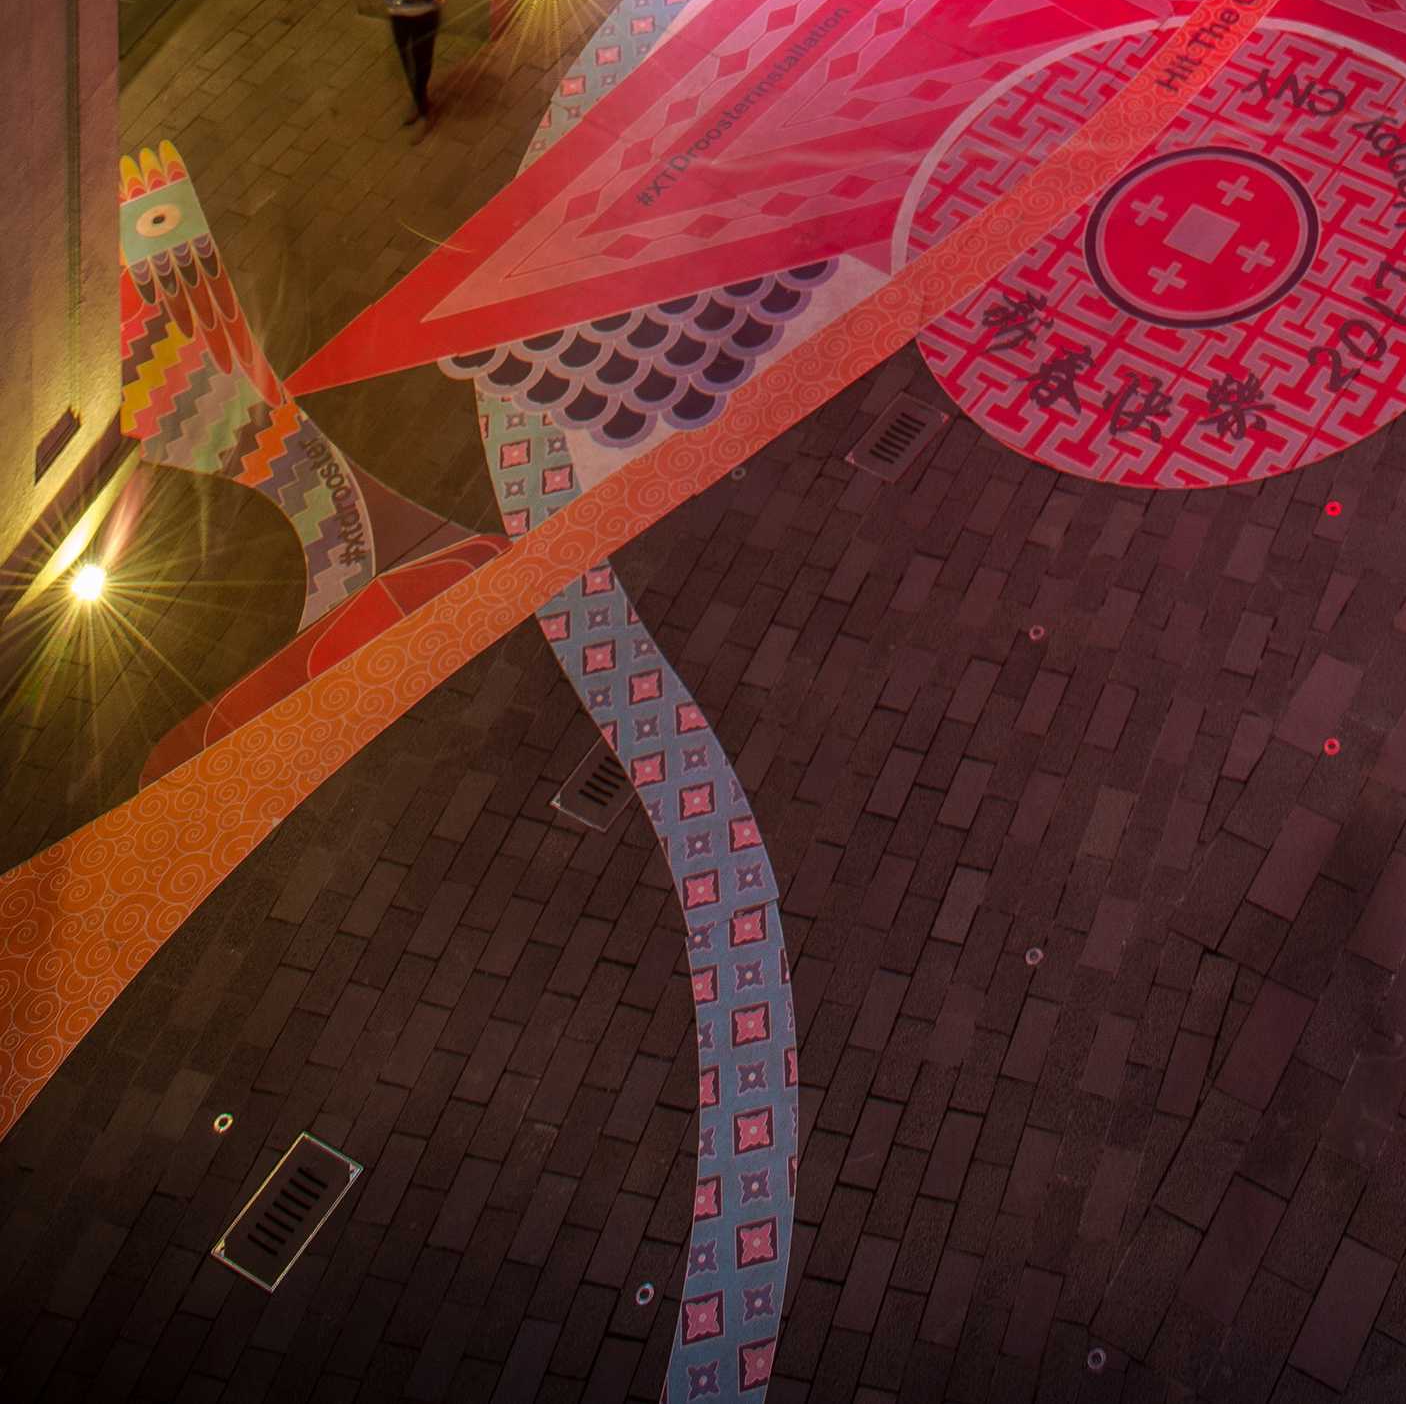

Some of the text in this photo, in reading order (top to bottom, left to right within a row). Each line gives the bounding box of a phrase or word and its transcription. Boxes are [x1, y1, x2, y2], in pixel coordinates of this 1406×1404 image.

[1155, 56, 1202, 92] Hit
[1188, 9, 1240, 49] The
[636, 6, 850, 206] #XTDroosterinstallation
[1241, 68, 1346, 117] CNY
